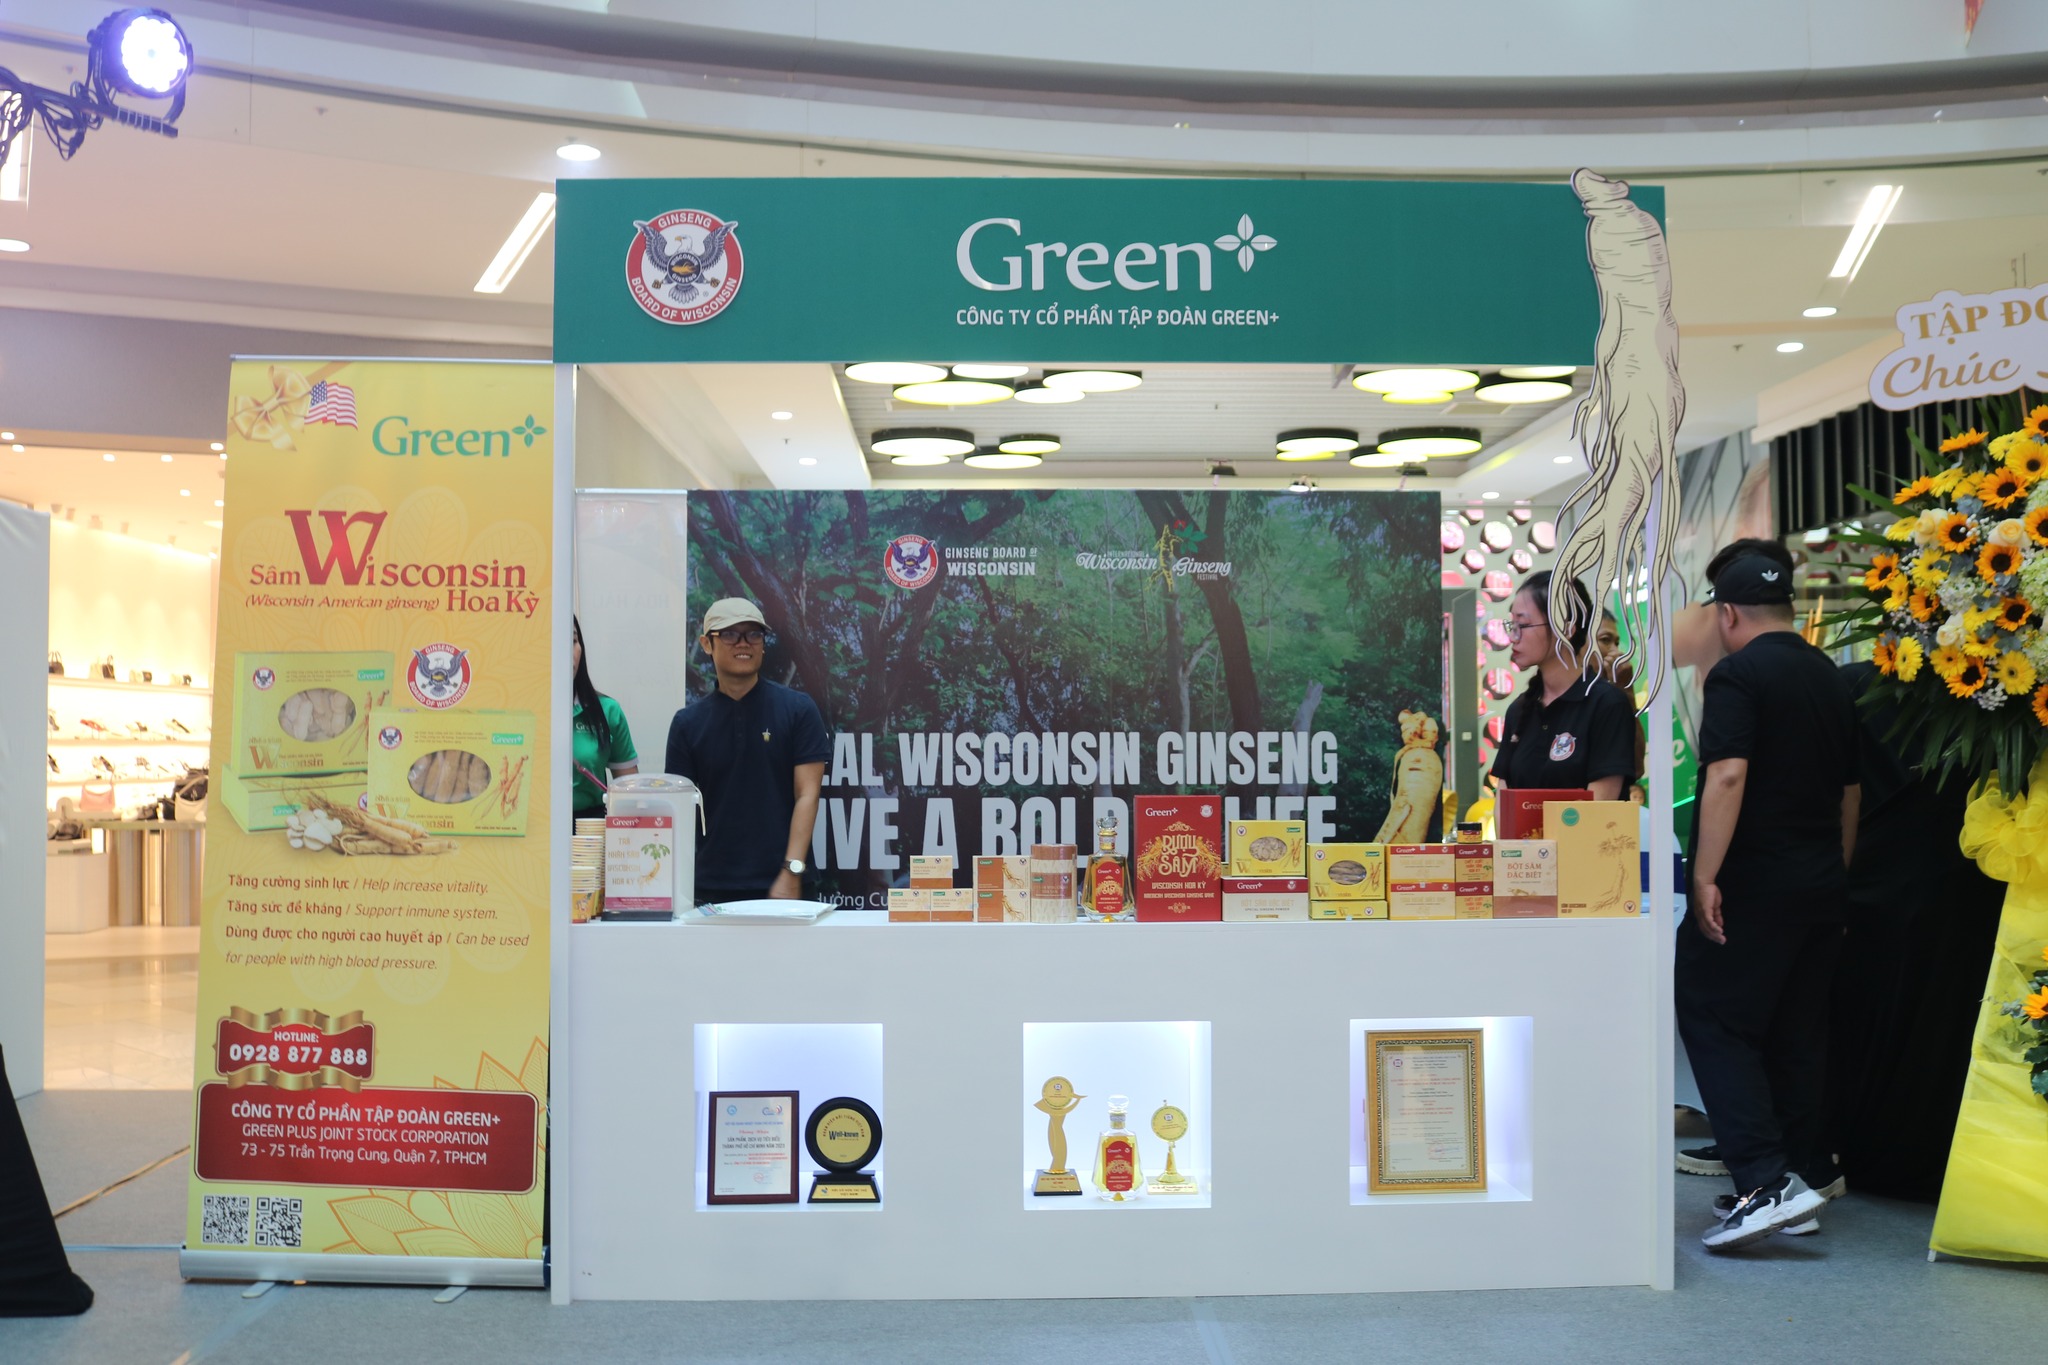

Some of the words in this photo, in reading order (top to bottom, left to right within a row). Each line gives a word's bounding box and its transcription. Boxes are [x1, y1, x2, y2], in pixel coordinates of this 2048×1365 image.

[658, 212, 712, 228] GINSENG
[631, 276, 661, 313] BOARD
[661, 308, 678, 320] OF
[681, 277, 737, 320] WISCONSIN
[956, 305, 1003, 325] CÔNG
[1009, 309, 1031, 325] TY
[1036, 301, 1058, 325] CỔ
[1064, 303, 1113, 325] PHẦN
[1118, 305, 1152, 329] TẬP
[1156, 305, 1206, 325] ĐOÀN
[1211, 309, 1279, 325] GREEN+
[1910, 302, 1989, 345] TẬP
[1883, 351, 2021, 398] Chúc
[249, 563, 301, 586] Sâm
[284, 509, 527, 588] Wisconsin
[944, 546, 989, 559] GINSENG
[992, 546, 1026, 559] BOARD
[1030, 547, 1038, 557] OF
[946, 561, 1036, 577] WISCONSIN
[1076, 552, 1158, 570] Wisconsin
[1172, 556, 1232, 576] Ginseng
[245, 593, 314, 609] (Wisconsin
[318, 595, 383, 609] American
[385, 596, 440, 612] ginseng)
[446, 588, 500, 613] Hoa
[504, 589, 540, 619] Kỳ
[424, 644, 455, 656] GINSENG
[408, 681, 428, 707] BOARD
[425, 699, 435, 709] OF
[436, 681, 468, 708] WISCONSIN
[898, 732, 1140, 786] WISCONSIN
[1158, 731, 1338, 786] GINSENG
[922, 797, 959, 869] A
[228, 874, 259, 890] Tăng
[262, 876, 301, 891] cường
[304, 876, 329, 889] sinh
[332, 877, 350, 892] lực
[353, 878, 359, 890] /
[361, 878, 390, 894] Help
[393, 879, 443, 893] increase
[446, 880, 489, 897] vitality.
[1151, 882, 1184, 890] WISCONSIN
[1184, 882, 1197, 890] HOA
[227, 899, 258, 915] Tăng
[261, 901, 282, 914] sức
[305, 902, 342, 918] kháng
[345, 904, 351, 915] /
[355, 904, 403, 919] Support
[405, 906, 450, 919] inmune
[452, 908, 498, 921] system.
[225, 925, 258, 942] Dùng
[262, 926, 293, 942] được
[296, 927, 318, 941] cho
[321, 927, 356, 944] người
[360, 931, 381, 941] cao
[385, 929, 423, 945] huyết
[427, 930, 443, 945] áp
[455, 932, 478, 946] Can
[480, 932, 496, 946] be
[499, 933, 530, 947] used
[225, 951, 244, 965] for
[245, 953, 286, 967] people
[289, 952, 316, 966] with
[318, 954, 343, 969] high
[346, 954, 380, 968] blood
[380, 957, 438, 971] pressure.
[274, 1031, 319, 1043] HOTLINE:
[229, 1043, 280, 1062] 0928
[287, 1046, 323, 1064] 877
[330, 1047, 368, 1065] 888
[231, 1102, 272, 1119] CÔNG
[275, 1105, 294, 1119] TY
[297, 1100, 316, 1120] CỔ
[319, 1104, 361, 1122] PHẦN
[364, 1107, 394, 1126] TẬP
[397, 1106, 440, 1125] ĐOÀN
[443, 1110, 501, 1127] GREEN+
[242, 1123, 284, 1138] GREEN
[286, 1125, 317, 1139] PLUS
[319, 1126, 354, 1142] JOINT
[356, 1128, 398, 1142] STOCK
[400, 1130, 489, 1146] CORPORATION
[240, 1142, 258, 1157] 73
[269, 1143, 286, 1157] 75
[288, 1142, 315, 1159] Trần
[318, 1145, 354, 1163] Trọng
[357, 1147, 390, 1164] Cung,
[393, 1148, 426, 1165] Quận
[428, 1150, 441, 1165] 7,
[443, 1151, 487, 1166] TPHCM
